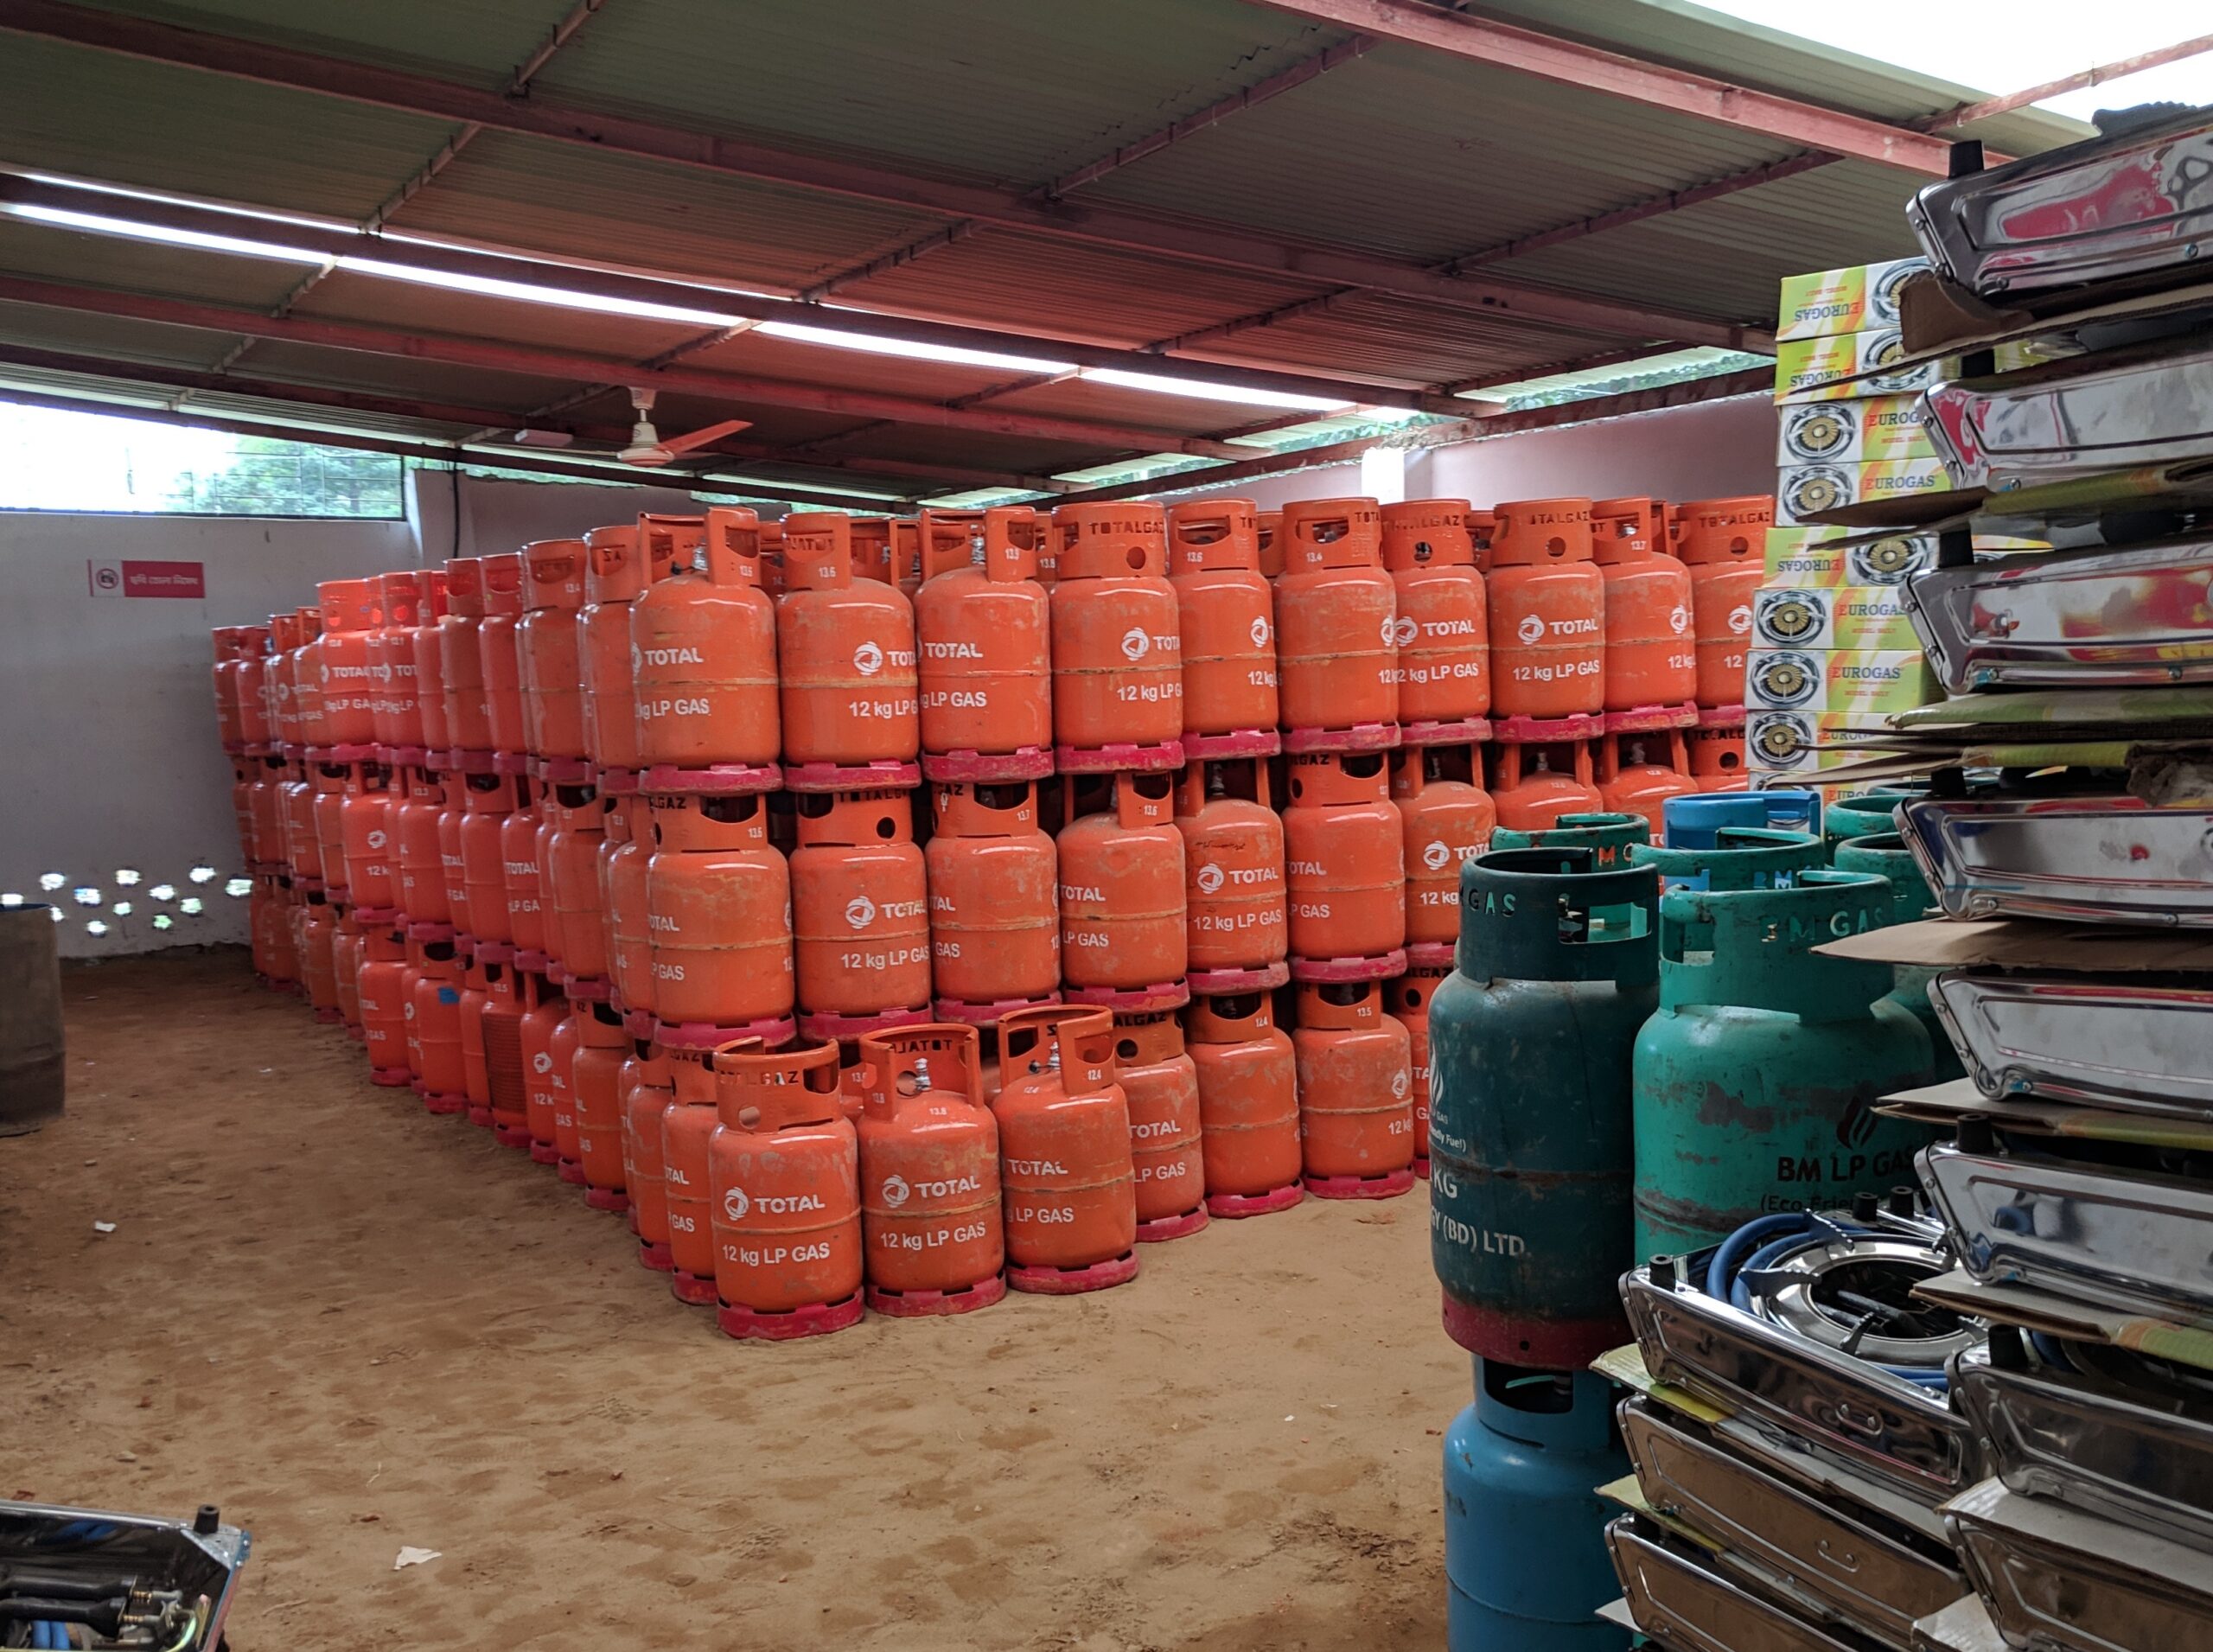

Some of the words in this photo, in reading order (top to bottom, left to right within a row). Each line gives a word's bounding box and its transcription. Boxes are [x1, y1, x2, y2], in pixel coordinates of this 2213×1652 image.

[1794, 301, 1859, 322] EUROGAS
[1865, 475, 1935, 490] EUROGAS
[1777, 558, 1840, 572] EUROGAS
[1421, 619, 1476, 638] TOTAL
[1549, 618, 1598, 635] TOTAL
[645, 648, 705, 666] TOTAL
[925, 642, 984, 659] TOTAL
[1513, 667, 1532, 681] 12
[1534, 665, 1553, 681] kg
[1556, 663, 1575, 678] LP
[1578, 660, 1600, 674] GAS
[1725, 655, 1743, 669] 12
[1247, 671, 1262, 686] 12
[1409, 667, 1426, 683] kg
[1431, 664, 1450, 680] LP
[1453, 661, 1479, 678] GAS
[1831, 667, 1901, 679] EUROGAS
[931, 692, 947, 707] LP
[950, 692, 987, 707] GAS
[1117, 686, 1138, 702] 12
[1140, 686, 1158, 702] kg
[1160, 684, 1174, 699] LP
[652, 701, 672, 717] LP
[675, 698, 710, 716] GAS
[849, 702, 872, 718] 12
[874, 701, 893, 719] kg
[894, 701, 910, 716] LP
[1228, 867, 1279, 884] TOTAL
[1060, 885, 1106, 903] TOTAL
[1419, 892, 1438, 906] 12
[1441, 890, 1460, 907] kg
[1469, 887, 1517, 918] GAS
[880, 900, 928, 919] TOTAL
[1300, 904, 1330, 919] GAS
[1194, 916, 1212, 931] 12
[1215, 915, 1234, 931] kg
[1237, 914, 1256, 928] LP
[1260, 909, 1283, 926] GAS
[1062, 933, 1075, 946] LP
[1078, 933, 1109, 948] GAS
[840, 954, 862, 969] 12
[864, 953, 886, 969] kg
[889, 951, 909, 966] LP
[910, 947, 929, 963] GAS
[935, 943, 961, 959] GAS
[658, 966, 686, 981] GAS
[533, 1092, 547, 1106] 12
[1388, 1120, 1402, 1135] 12
[1007, 1158, 1068, 1176] TOTAL
[1156, 1162, 1187, 1181] GAS
[1777, 1157, 1821, 1183] BM
[1831, 1155, 1866, 1182] LP
[915, 1176, 981, 1198] TOTAL
[1433, 1164, 1458, 1199] KG
[754, 1194, 826, 1214] TOTAL
[673, 1214, 696, 1233] GAS
[1017, 1209, 1034, 1222] LP
[1037, 1207, 1075, 1224] GAS
[880, 1233, 899, 1249] 12
[902, 1232, 922, 1251] kg
[927, 1229, 950, 1247] LP
[953, 1221, 986, 1243] GAS
[1443, 1215, 1478, 1253] (BD)
[1483, 1229, 1532, 1257] LTD.
[723, 1243, 737, 1261] 12
[740, 1249, 760, 1267] kg
[763, 1247, 788, 1265] LP
[792, 1241, 831, 1263] GAS
